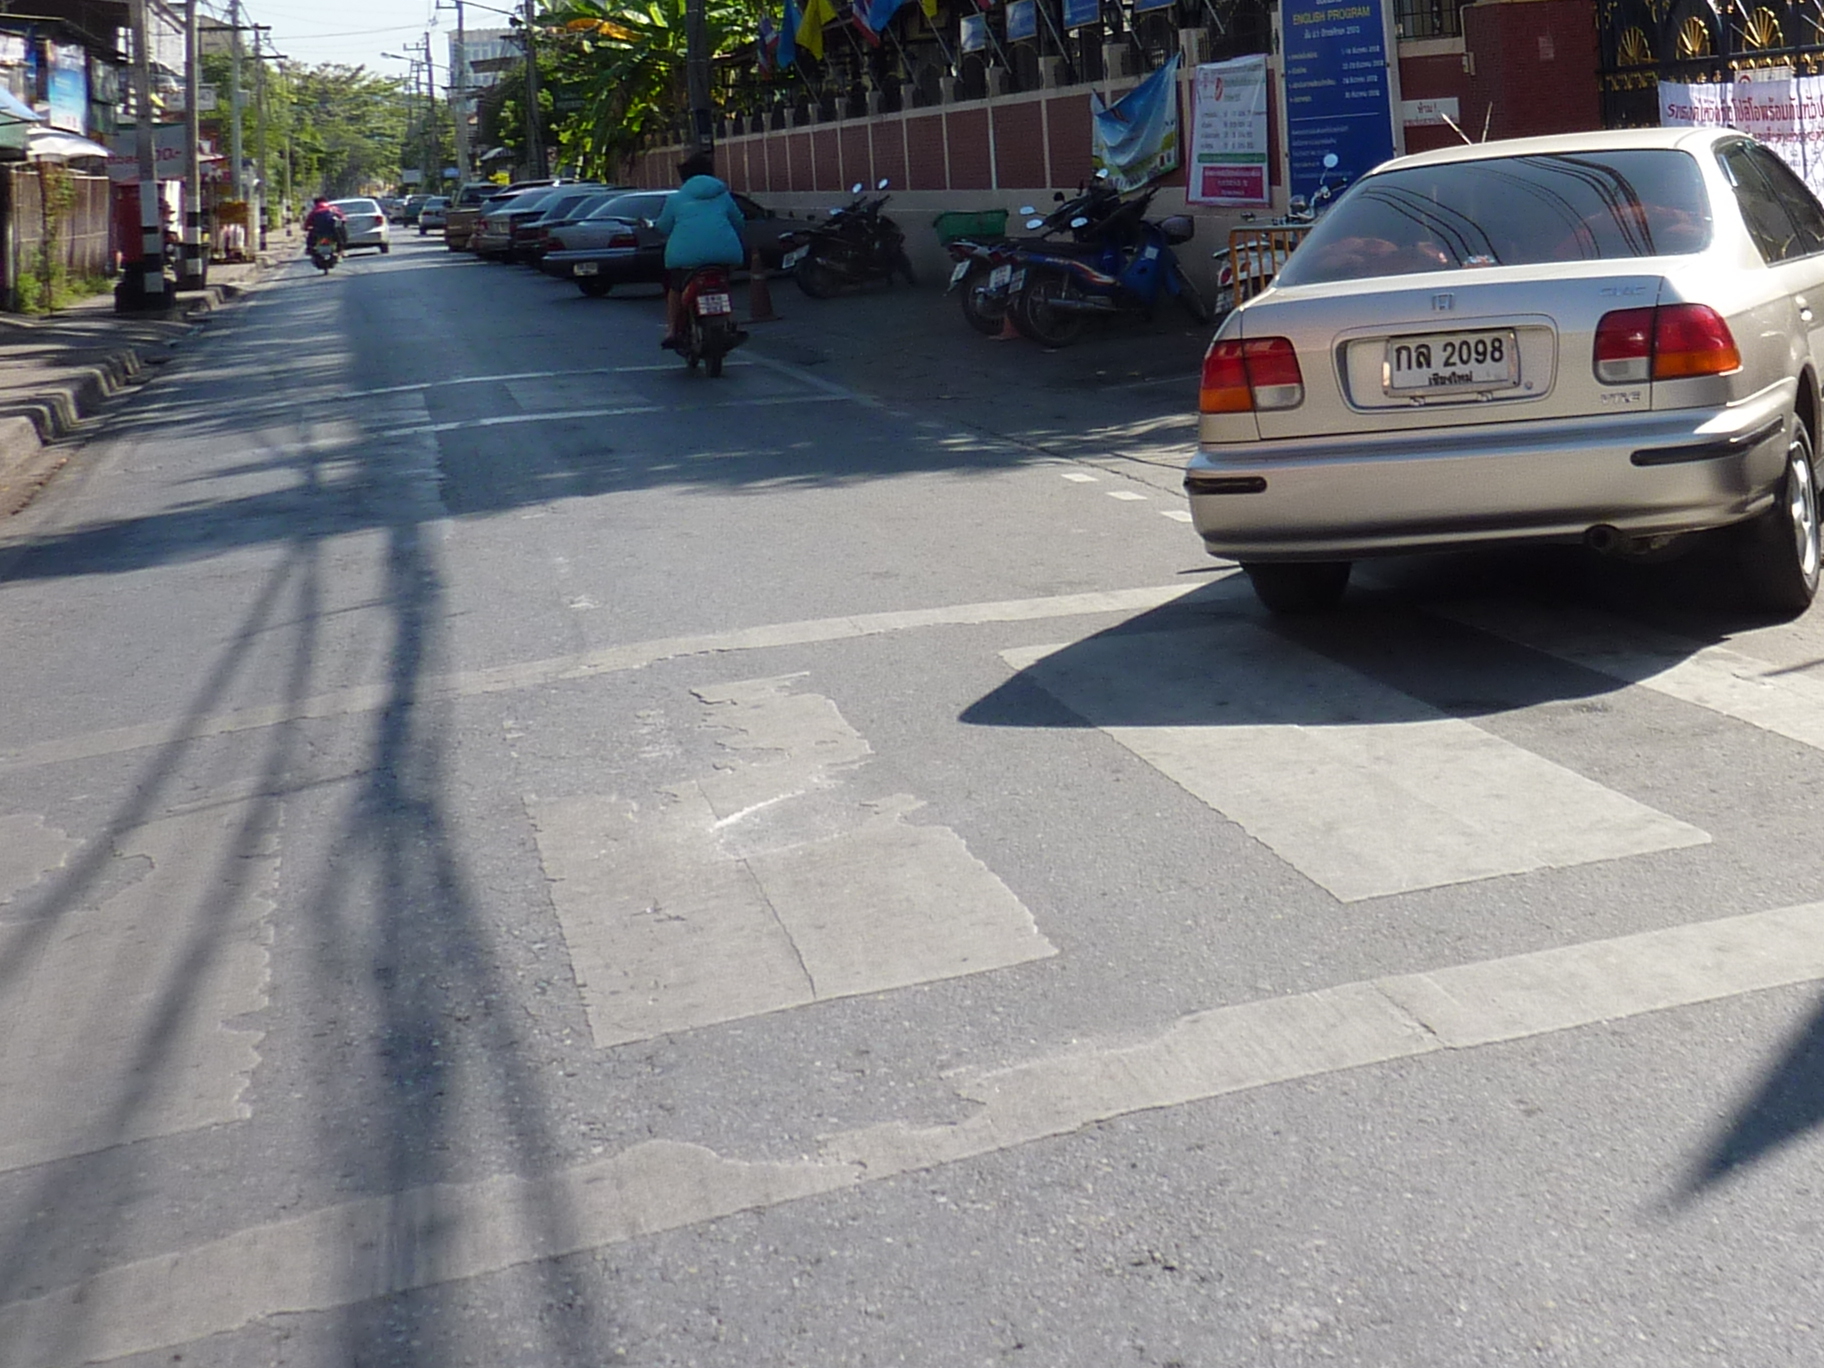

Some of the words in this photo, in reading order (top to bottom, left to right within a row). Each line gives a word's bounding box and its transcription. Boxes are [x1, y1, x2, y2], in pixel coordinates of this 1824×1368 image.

[1293, 12, 1326, 26] ENGLISH
[1327, 6, 1371, 21] PROGRAM
[1394, 343, 1432, 372] กล
[1443, 337, 1505, 368] 2098
